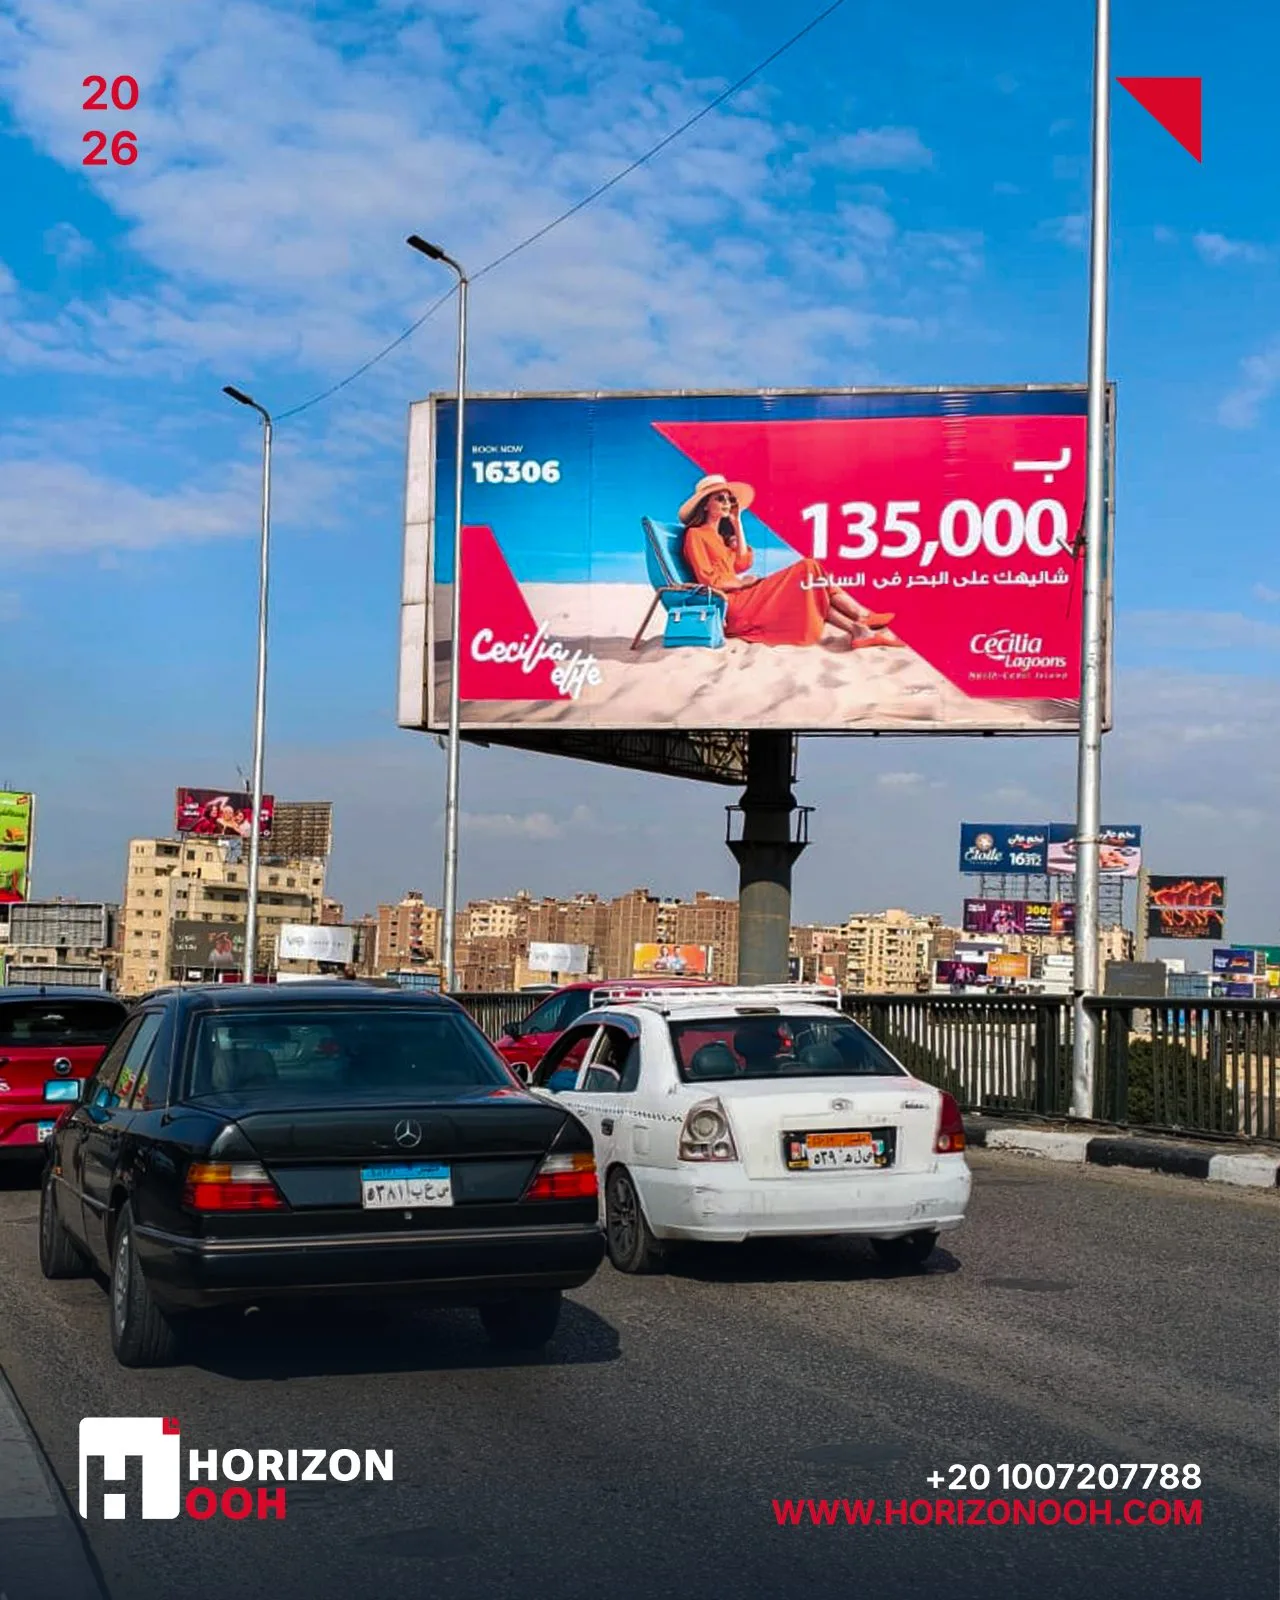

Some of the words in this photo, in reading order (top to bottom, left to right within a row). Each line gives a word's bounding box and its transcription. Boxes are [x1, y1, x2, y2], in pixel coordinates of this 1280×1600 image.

[472, 445, 498, 454] BOOK
[500, 445, 523, 453] NOW
[472, 460, 560, 483] 16306
[801, 498, 1068, 567] 135,000
[800, 572, 866, 590] الساحل
[907, 571, 948, 588] البحر
[471, 620, 569, 674] Cecilia
[1004, 655, 1067, 672] Lagoons
[550, 649, 603, 700] elite
